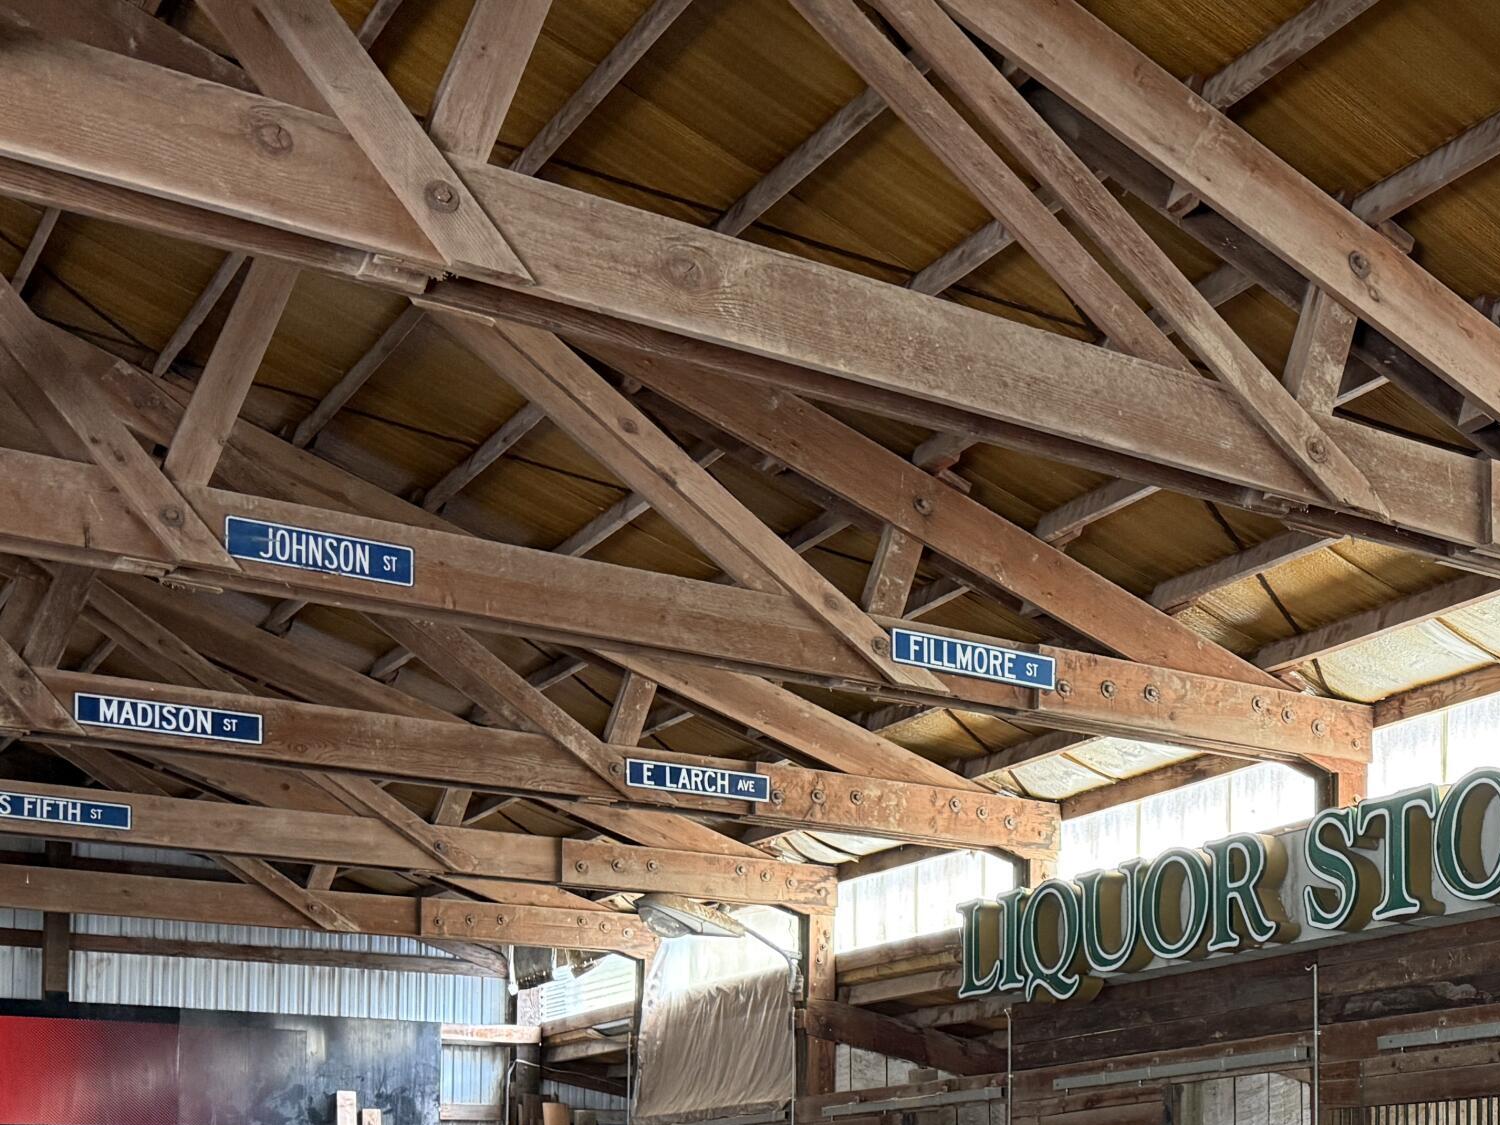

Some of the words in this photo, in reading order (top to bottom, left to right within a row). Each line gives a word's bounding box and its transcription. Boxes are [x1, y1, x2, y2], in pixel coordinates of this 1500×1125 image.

[260, 527, 370, 575] JOHNSON
[382, 553, 398, 572] ST
[908, 635, 1017, 681] FILLMORE
[1025, 662, 1040, 678] ST
[98, 698, 213, 735] MADISON
[222, 717, 239, 733] ST
[643, 763, 656, 786] E
[664, 770, 730, 794] LARCH
[737, 778, 756, 793] AVE
[0, 794, 12, 815] S
[23, 797, 81, 822] FIFTH
[90, 808, 103, 820] ST
[957, 832, 1275, 1001] LIQUOR
